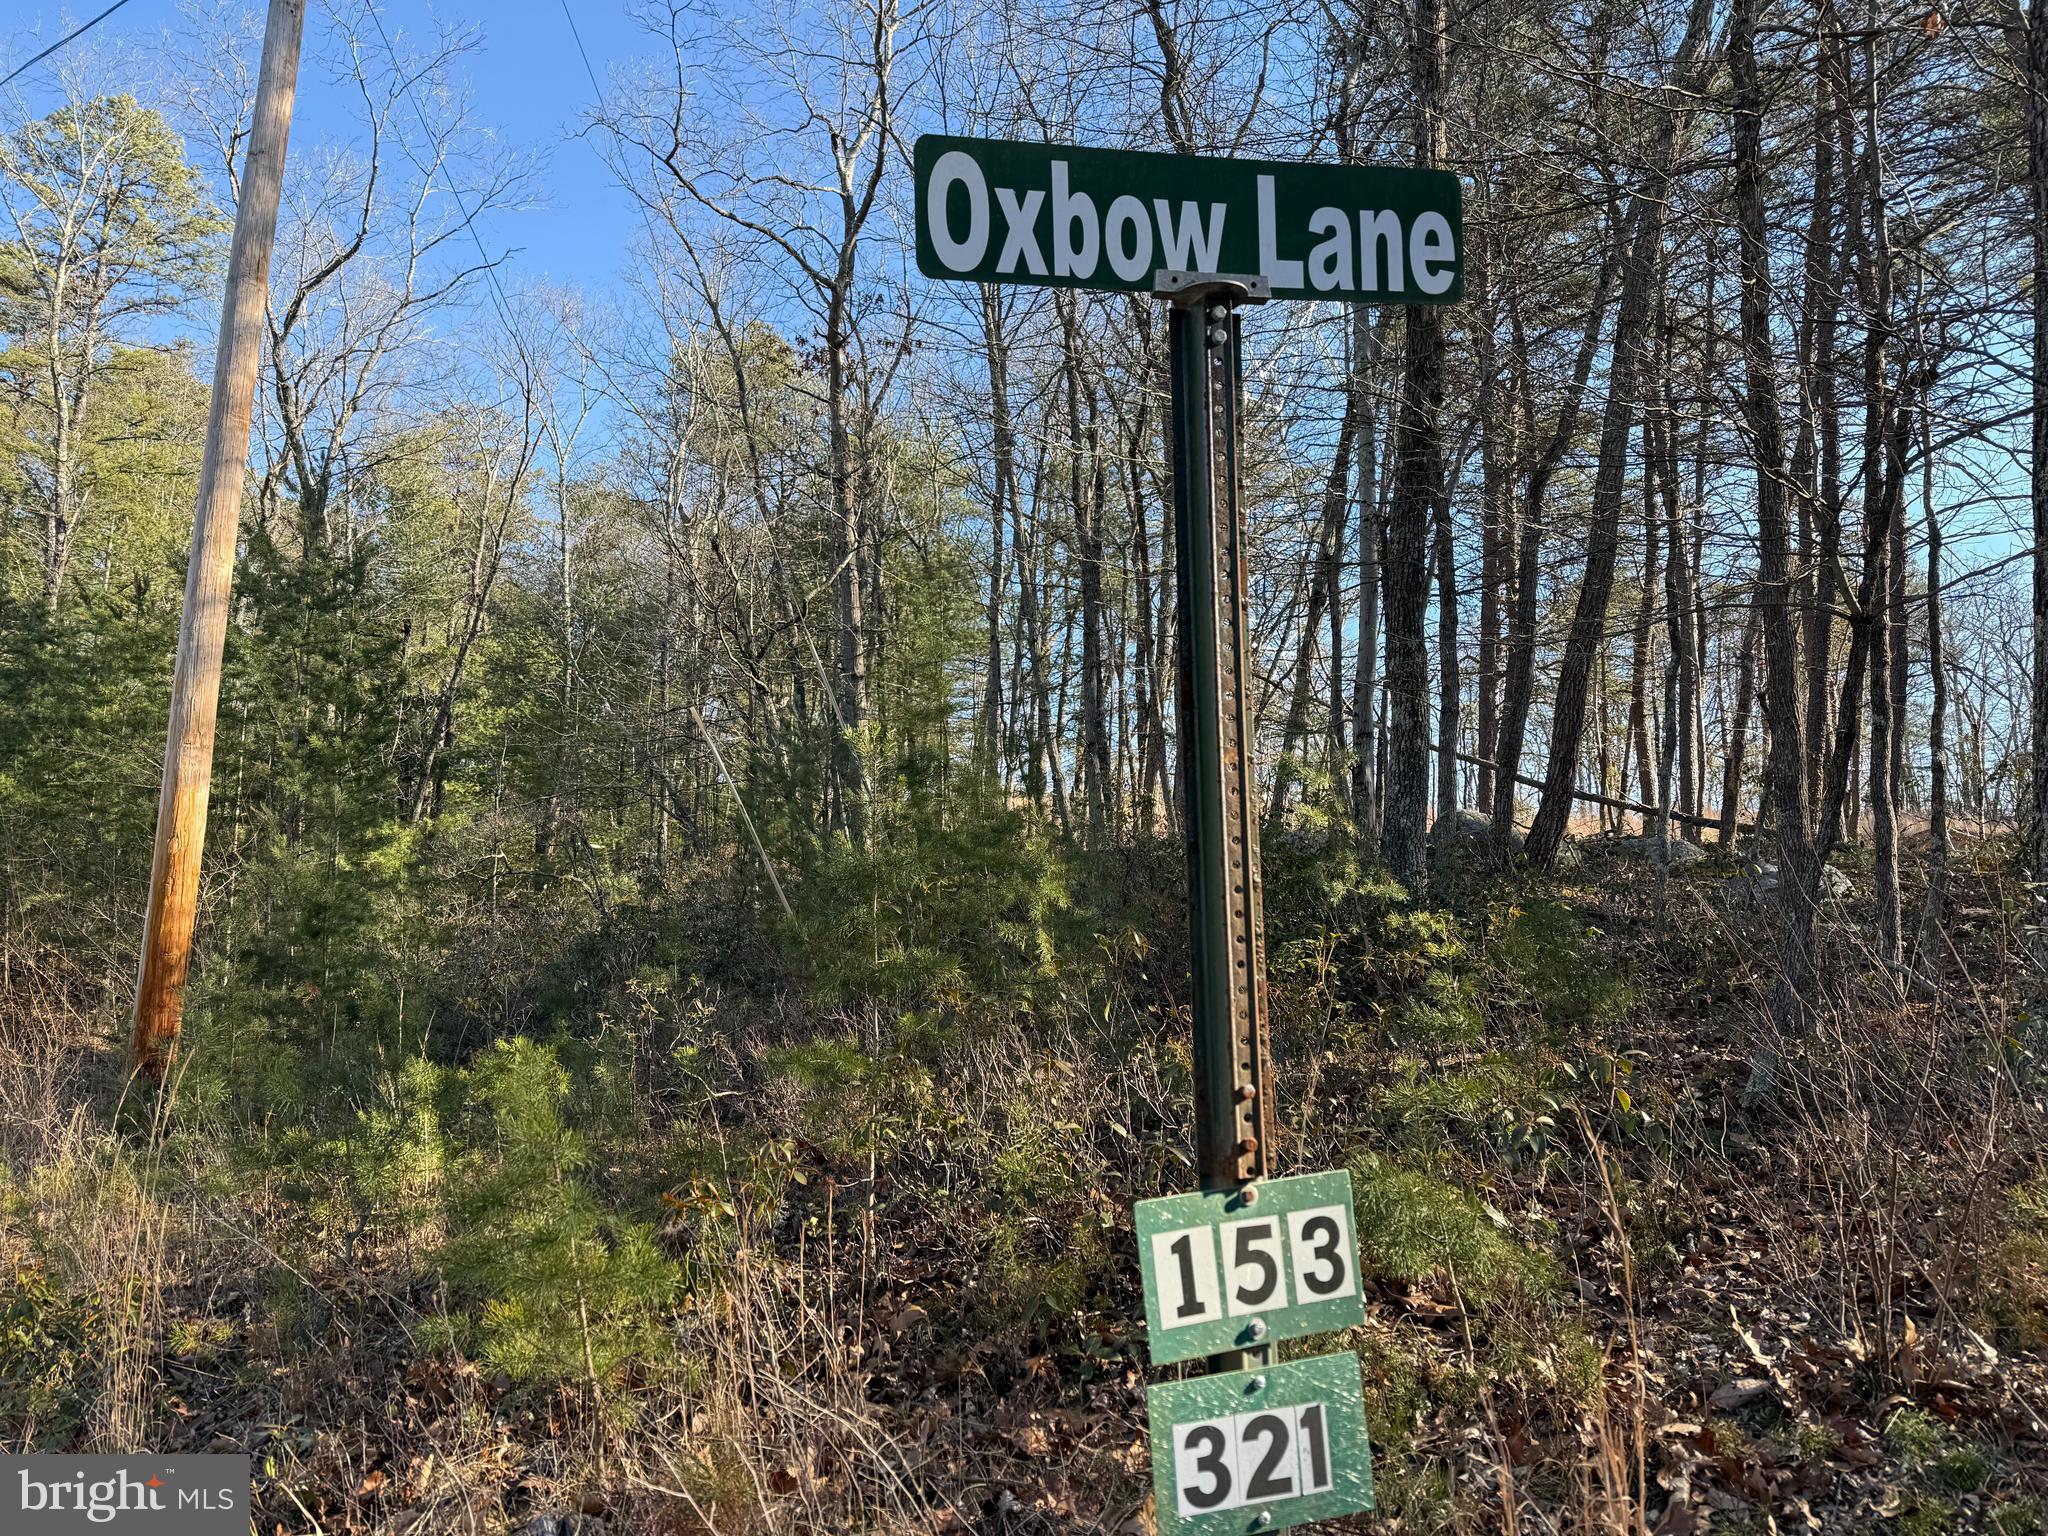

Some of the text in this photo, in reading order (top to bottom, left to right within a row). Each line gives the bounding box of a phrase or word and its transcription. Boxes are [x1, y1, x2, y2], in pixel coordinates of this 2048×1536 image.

[927, 151, 1456, 295] Oxbow Lane
[1171, 1216, 1346, 1318] 153
[1183, 1405, 1329, 1509] 321
